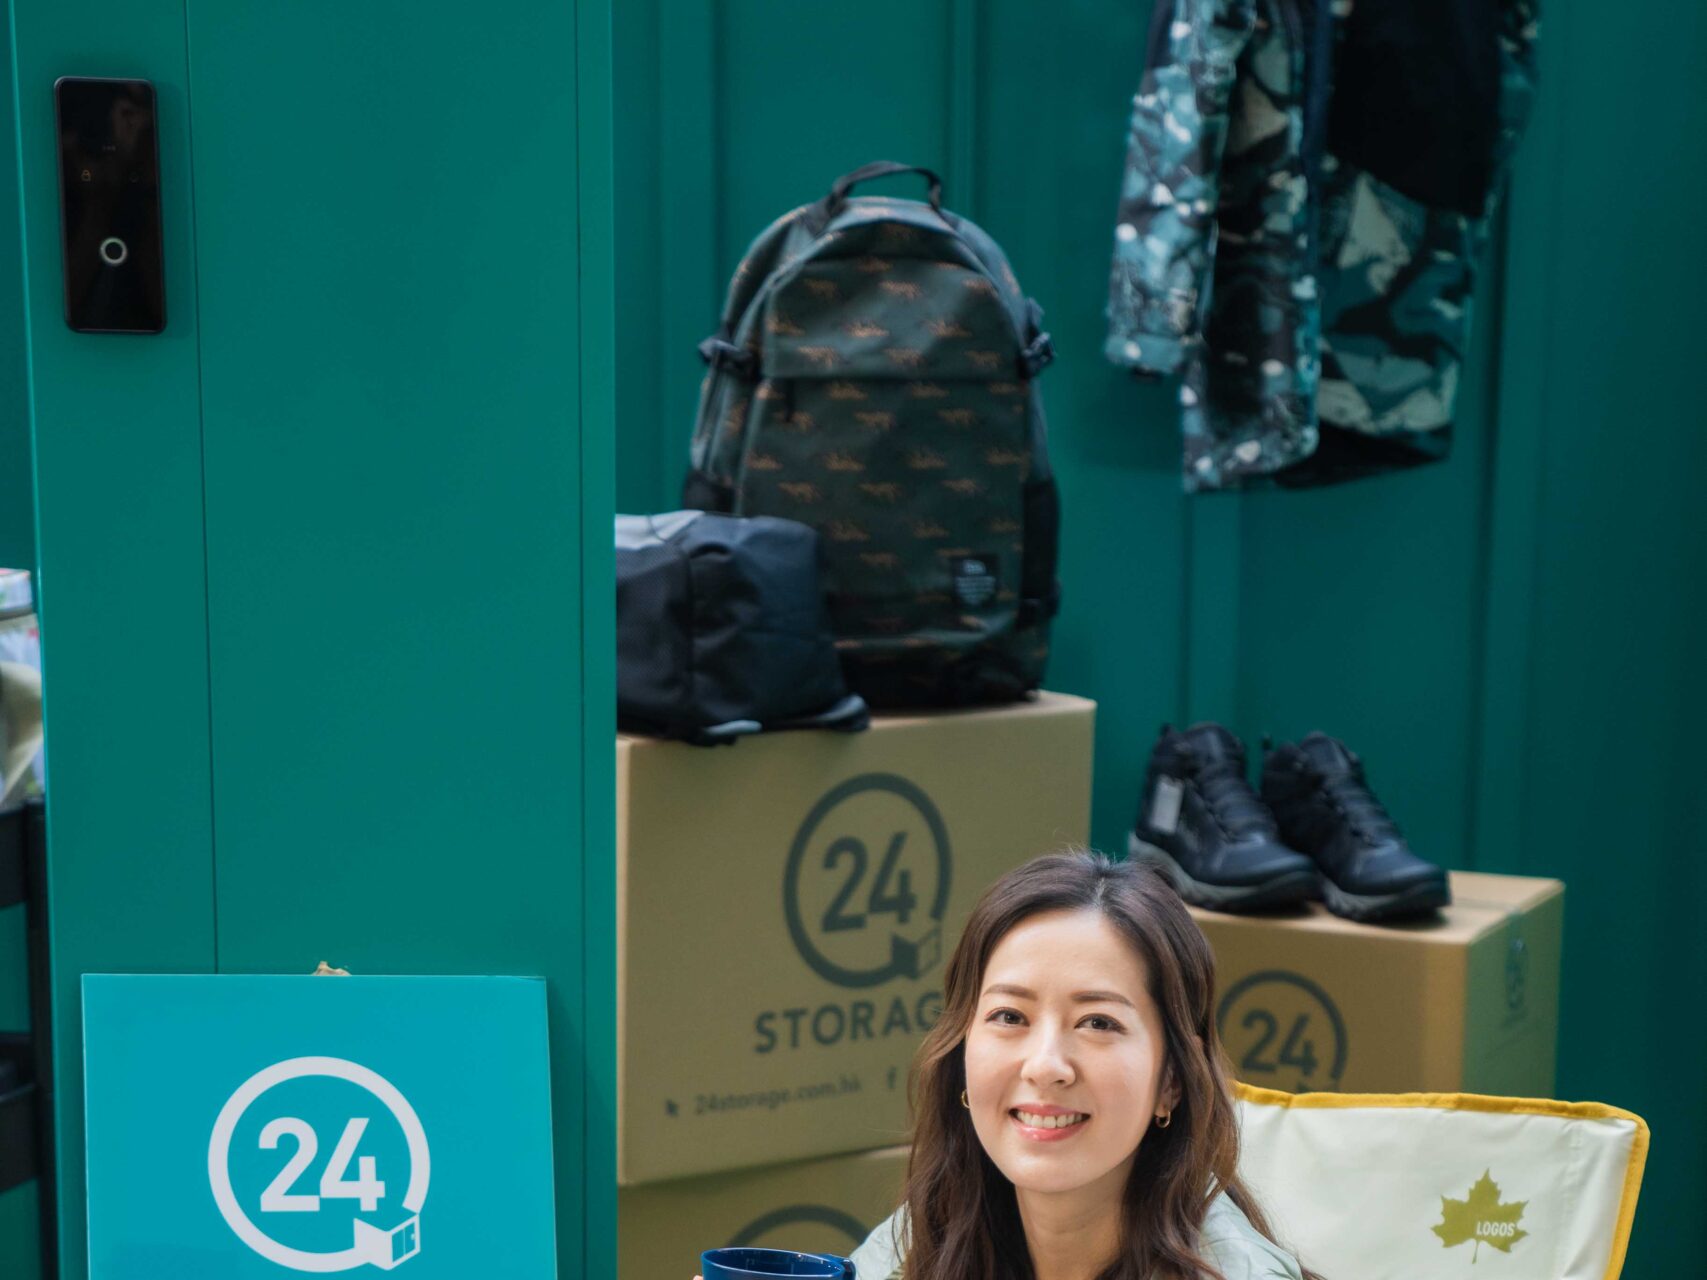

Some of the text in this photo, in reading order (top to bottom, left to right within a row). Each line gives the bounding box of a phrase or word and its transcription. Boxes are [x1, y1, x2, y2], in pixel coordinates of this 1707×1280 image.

[820, 832, 917, 933] 24
[754, 991, 942, 1054] STORAG
[1241, 1009, 1318, 1076] 24
[258, 1116, 386, 1212] 24
[1476, 1220, 1516, 1237] LOGOS
